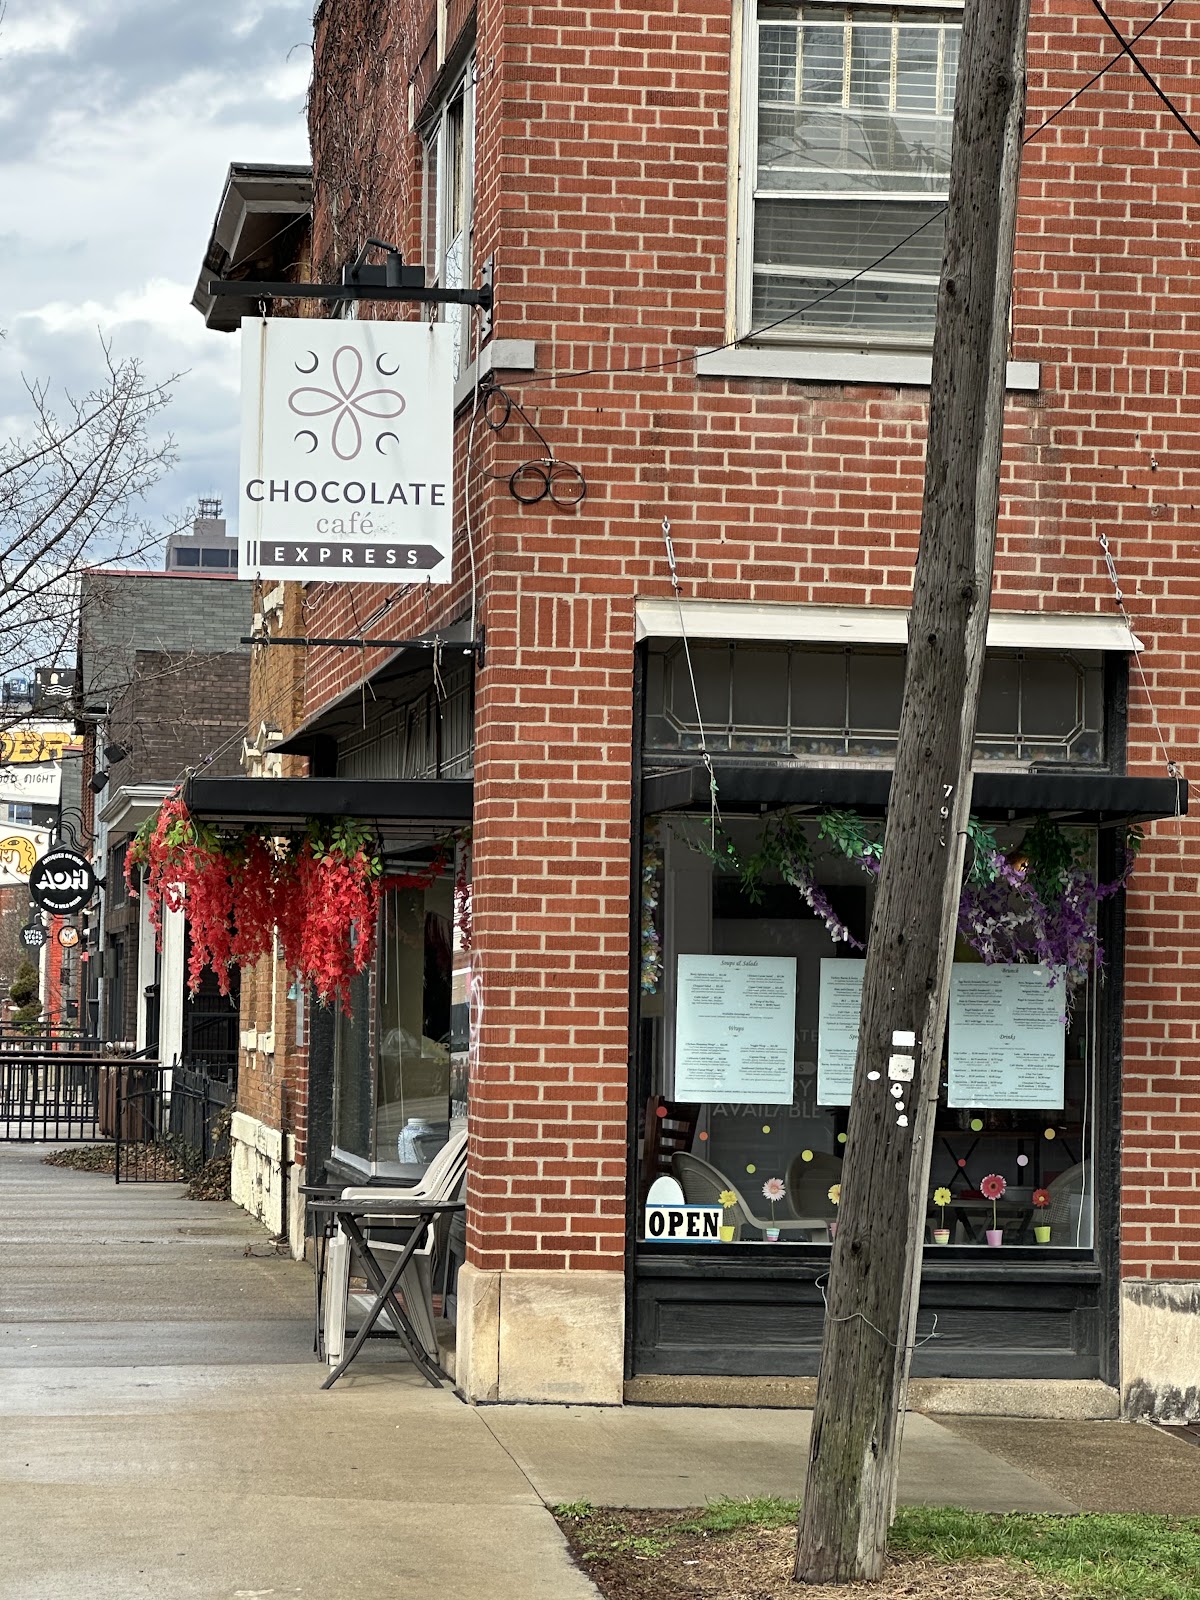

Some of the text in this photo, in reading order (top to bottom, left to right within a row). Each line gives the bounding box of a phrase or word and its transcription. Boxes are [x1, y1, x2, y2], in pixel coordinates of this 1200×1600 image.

[245, 479, 446, 506] CHOCOLATE
[316, 511, 374, 535] café
[274, 546, 418, 564] EXPRESS
[35, 869, 89, 890] AOH
[720, 960, 735, 968] Soups
[649, 1211, 719, 1237] OPEN
